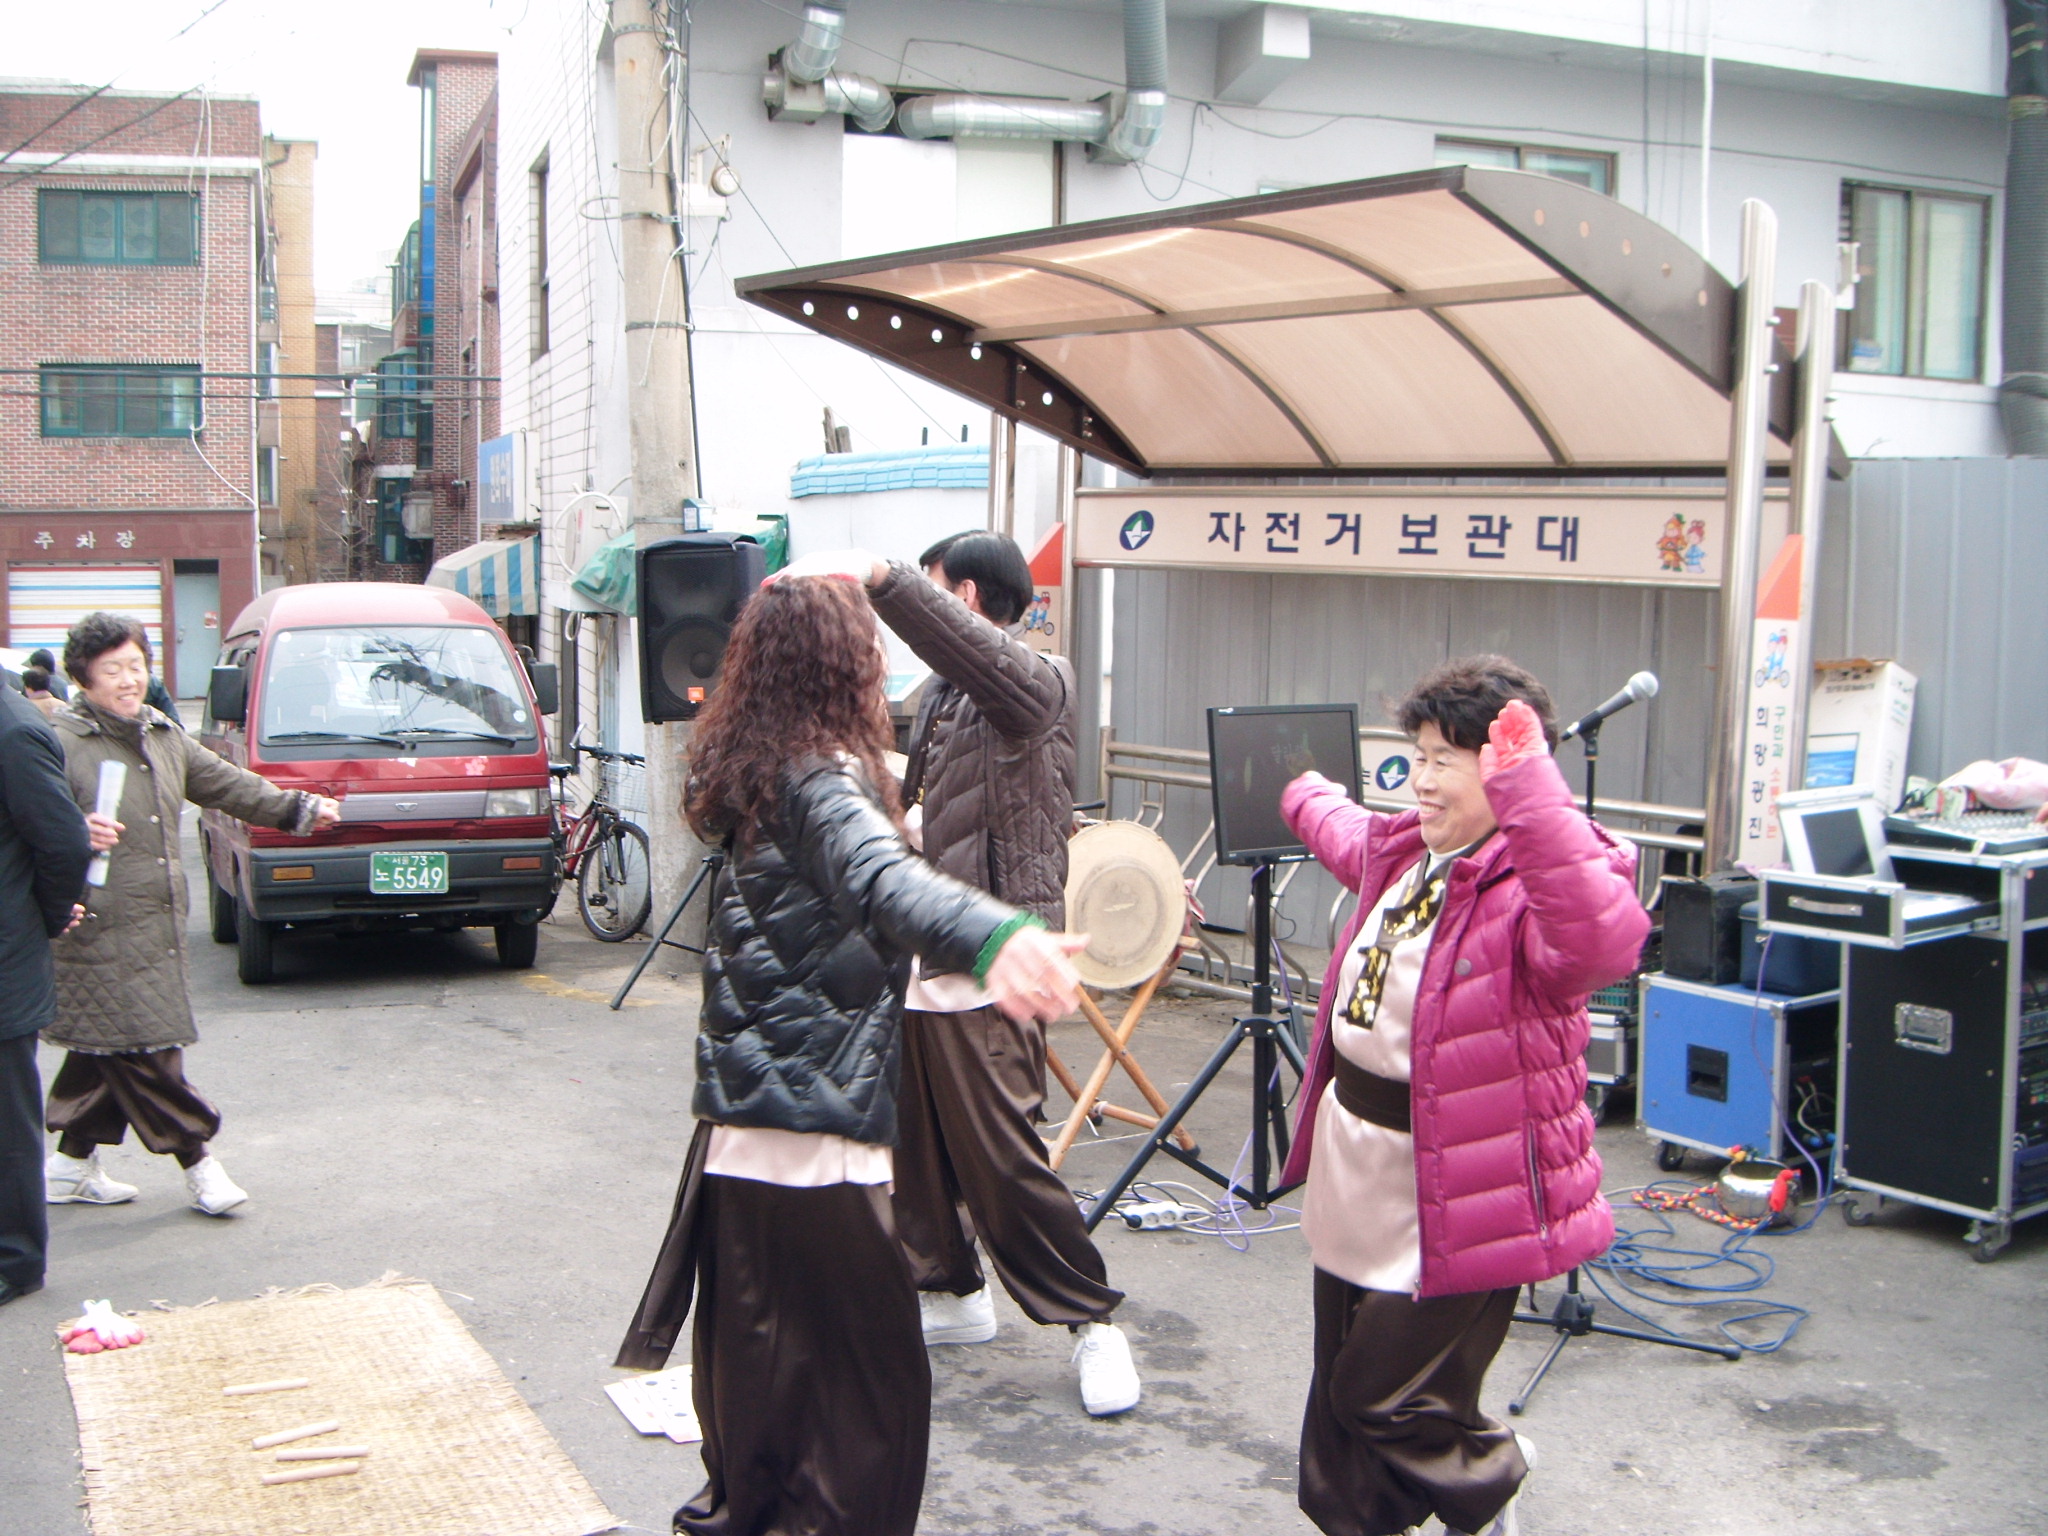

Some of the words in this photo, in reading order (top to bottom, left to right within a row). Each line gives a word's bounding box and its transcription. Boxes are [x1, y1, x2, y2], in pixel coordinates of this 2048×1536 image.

[33, 529, 136, 550] 주차장
[1209, 513, 1360, 554] 자전거
[1399, 515, 1578, 561] 보관대
[392, 855, 410, 865] 서울
[411, 855, 428, 866] 73
[393, 867, 443, 889] 5549
